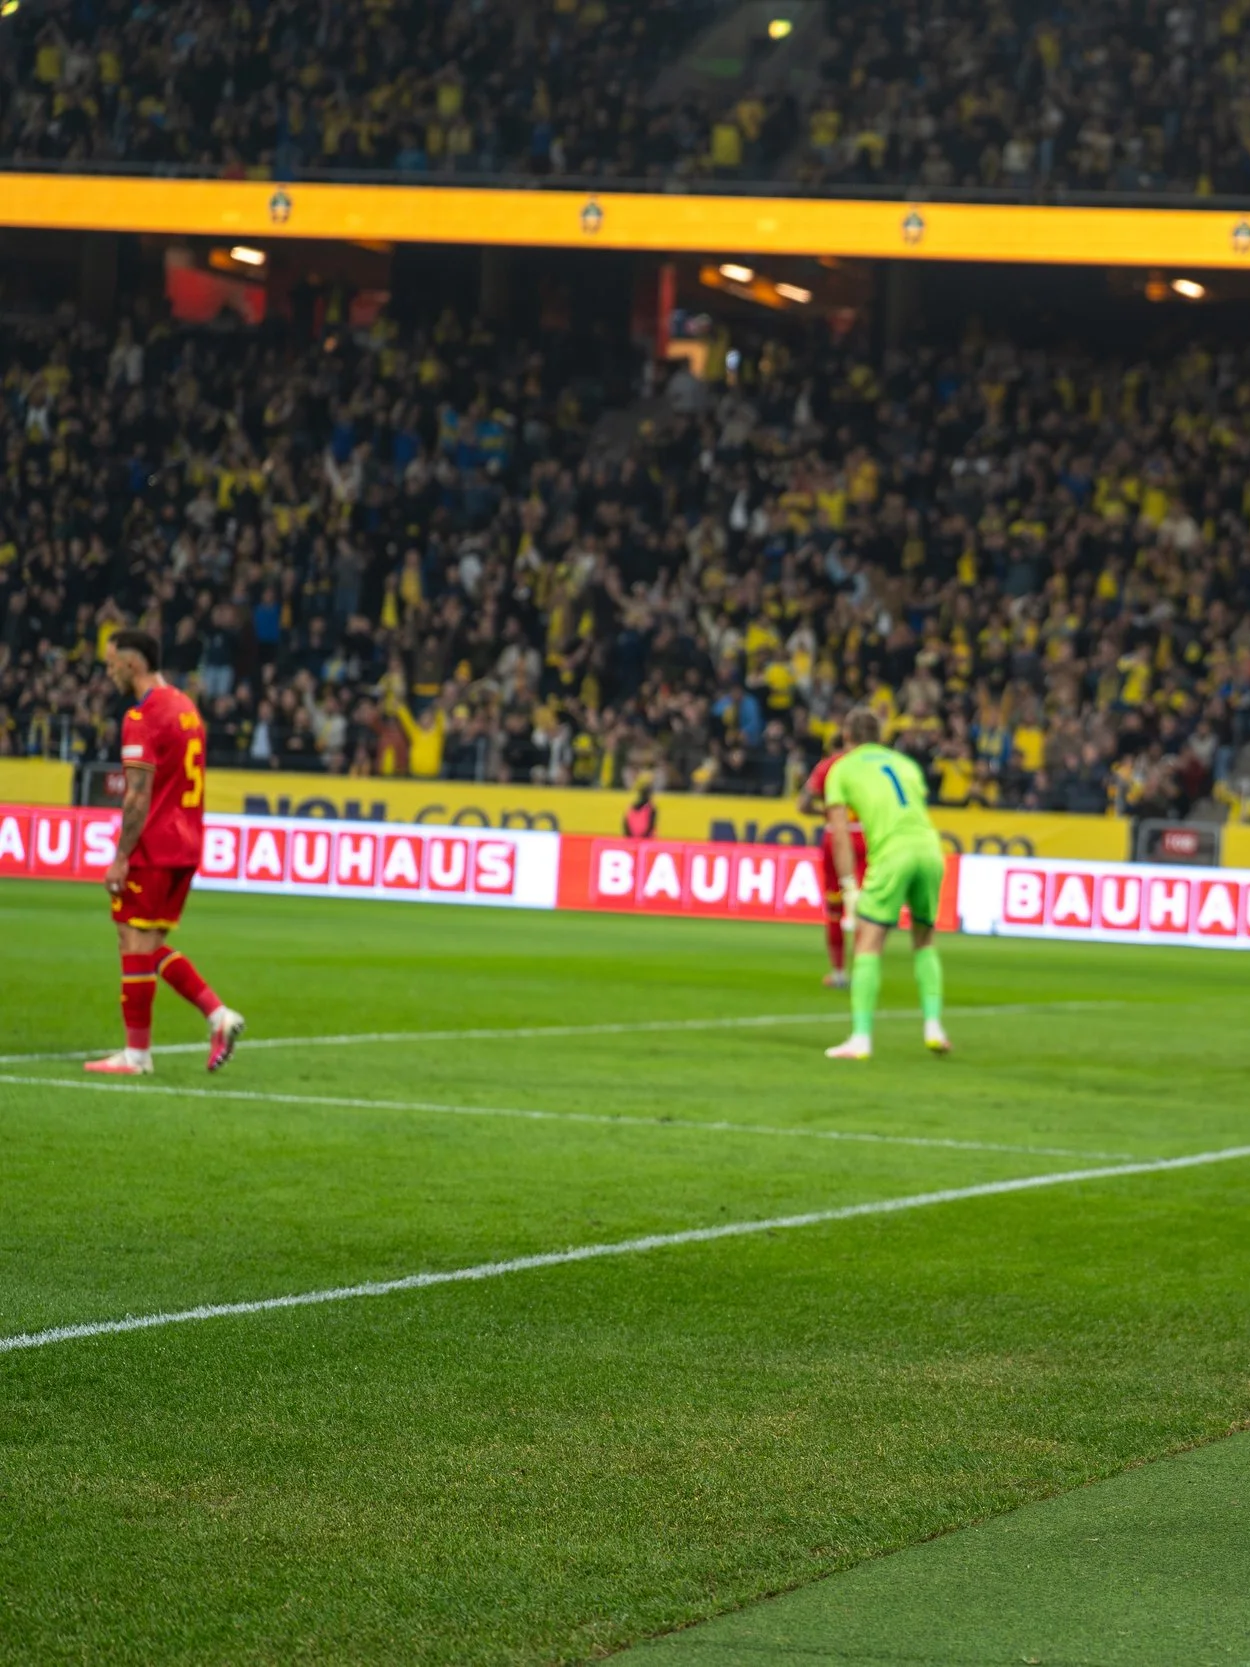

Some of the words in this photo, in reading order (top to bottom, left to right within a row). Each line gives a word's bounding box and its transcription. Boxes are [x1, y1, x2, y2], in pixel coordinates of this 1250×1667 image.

[182, 738, 204, 808] 5
[882, 764, 907, 807] 1
[203, 828, 514, 889] BAUHAUS
[598, 849, 822, 908] BAUHA
